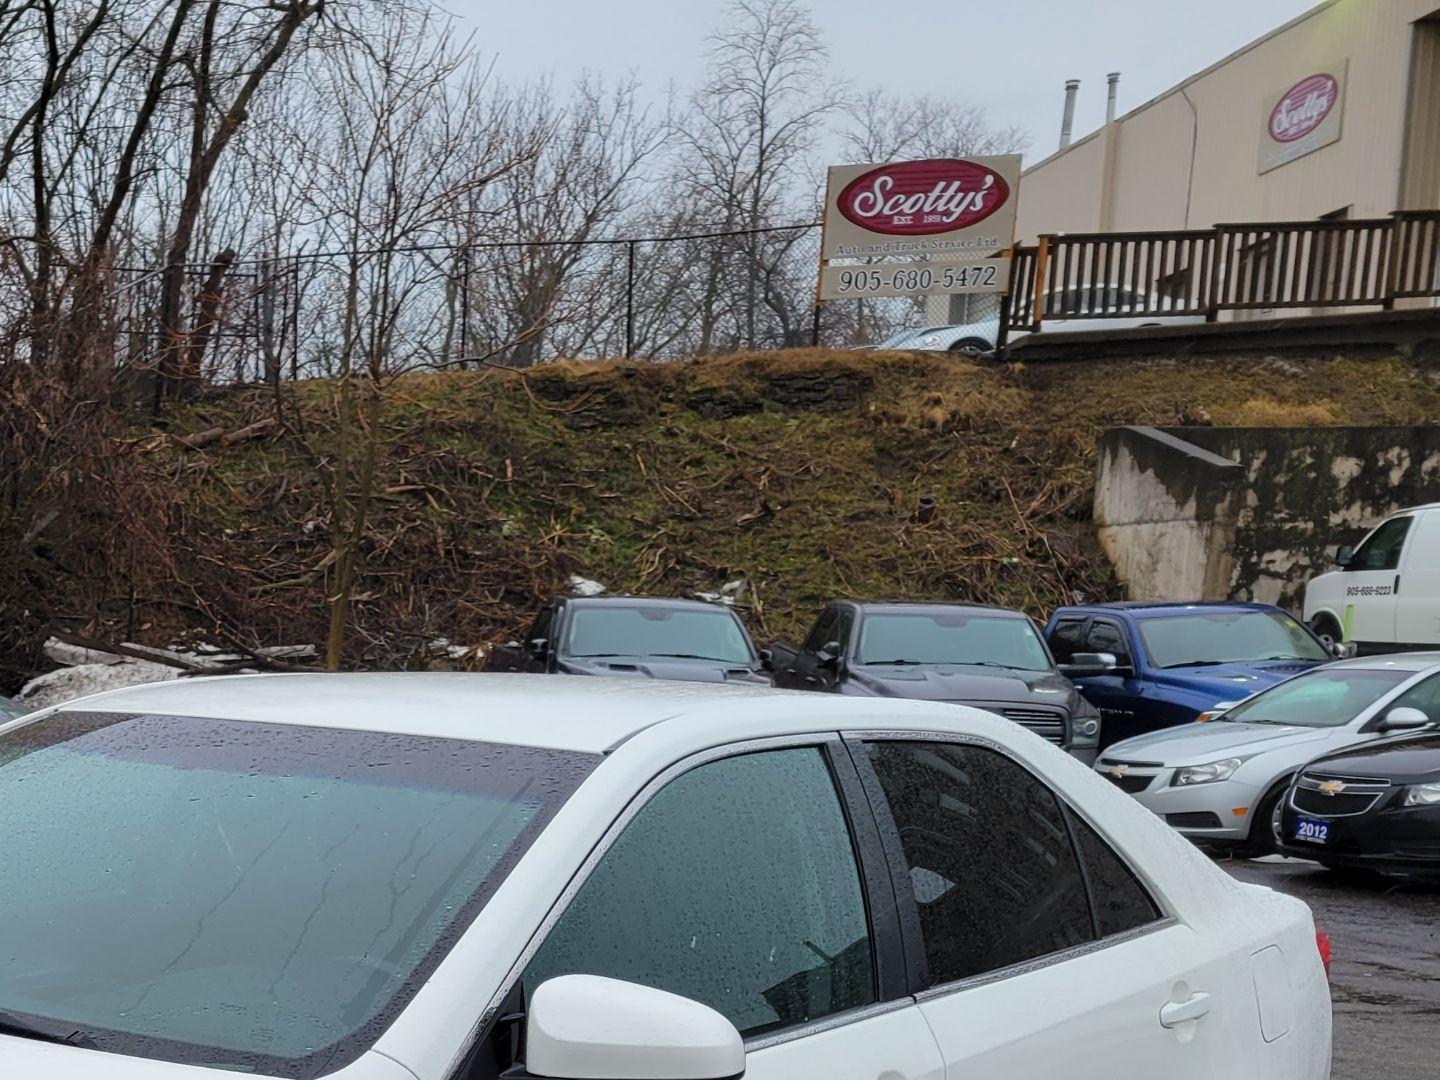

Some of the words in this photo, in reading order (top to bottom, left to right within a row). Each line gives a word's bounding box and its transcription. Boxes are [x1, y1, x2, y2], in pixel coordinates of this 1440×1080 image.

[853, 174, 995, 223] Scotty's
[835, 244, 864, 255] Auto
[869, 243, 890, 252] and
[895, 239, 928, 251] Truck
[931, 239, 973, 249] Service
[839, 265, 997, 292] 905-680-5472
[1298, 822, 1328, 839] 2012
